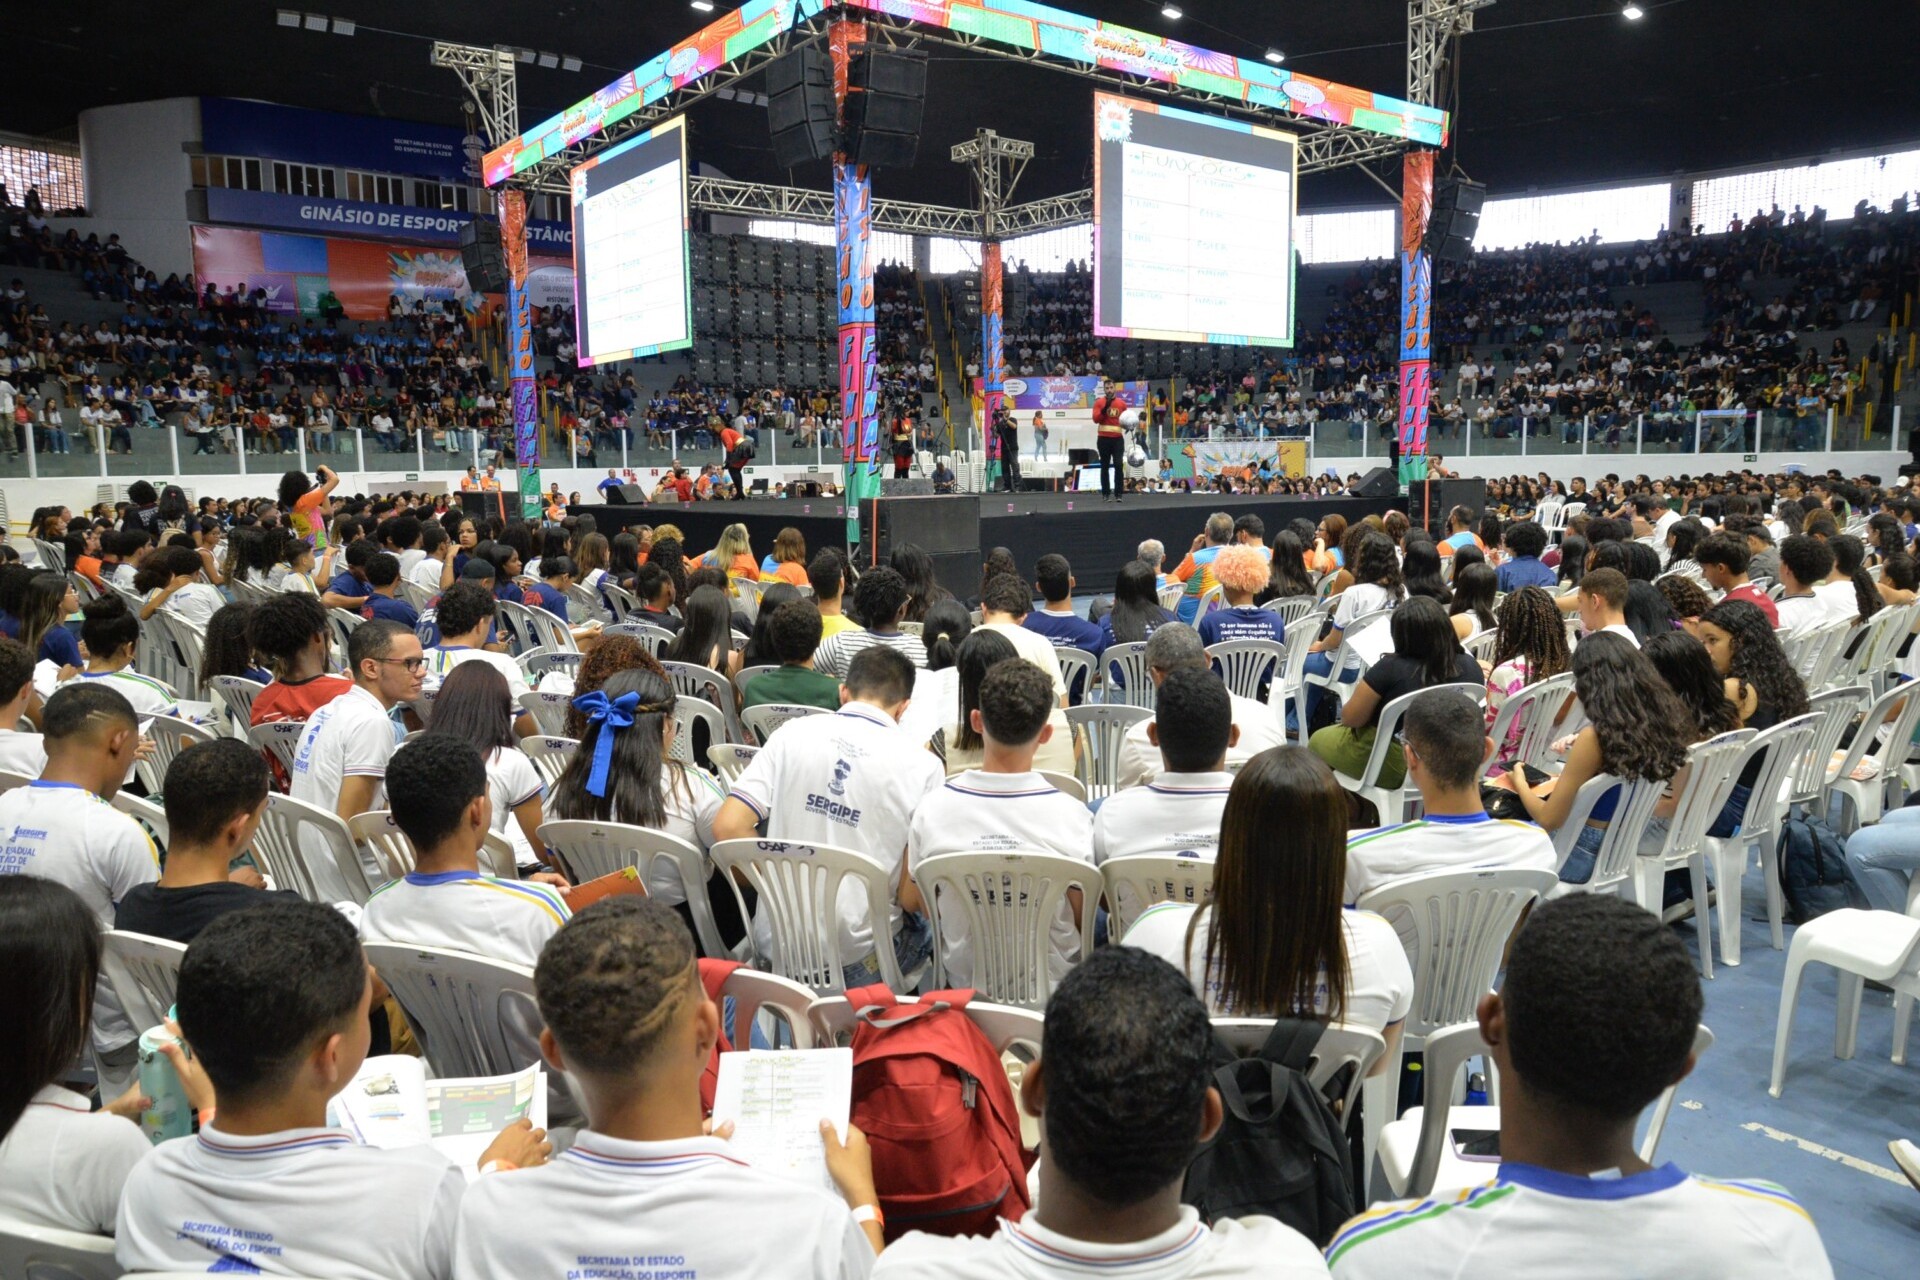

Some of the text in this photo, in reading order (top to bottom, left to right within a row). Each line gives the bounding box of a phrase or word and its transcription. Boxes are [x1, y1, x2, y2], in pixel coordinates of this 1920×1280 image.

[300, 205, 374, 226] GINÁSIO
[377, 213, 400, 227] DE
[842, 334, 857, 476] FINAL
[861, 334, 879, 476] FINAL
[1403, 366, 1417, 464] FINAL
[1419, 366, 1429, 464] FINAL
[521, 385, 537, 476] FINAL
[806, 793, 862, 823] SERGIPE
[17, 828, 48, 838] SERGIPE
[835, 818, 858, 828] ESTADO
[18, 856, 27, 865] DE
[183, 1221, 273, 1242] SECRETARIA DE ESTADO
[231, 1243, 247, 1252] DO
[248, 1243, 283, 1256] ESPORTE
[577, 1256, 685, 1266] SECRETARIA DE ESTADO
[567, 1268, 697, 1280] DA EDUCAÇÃO, DO ESPORTE
